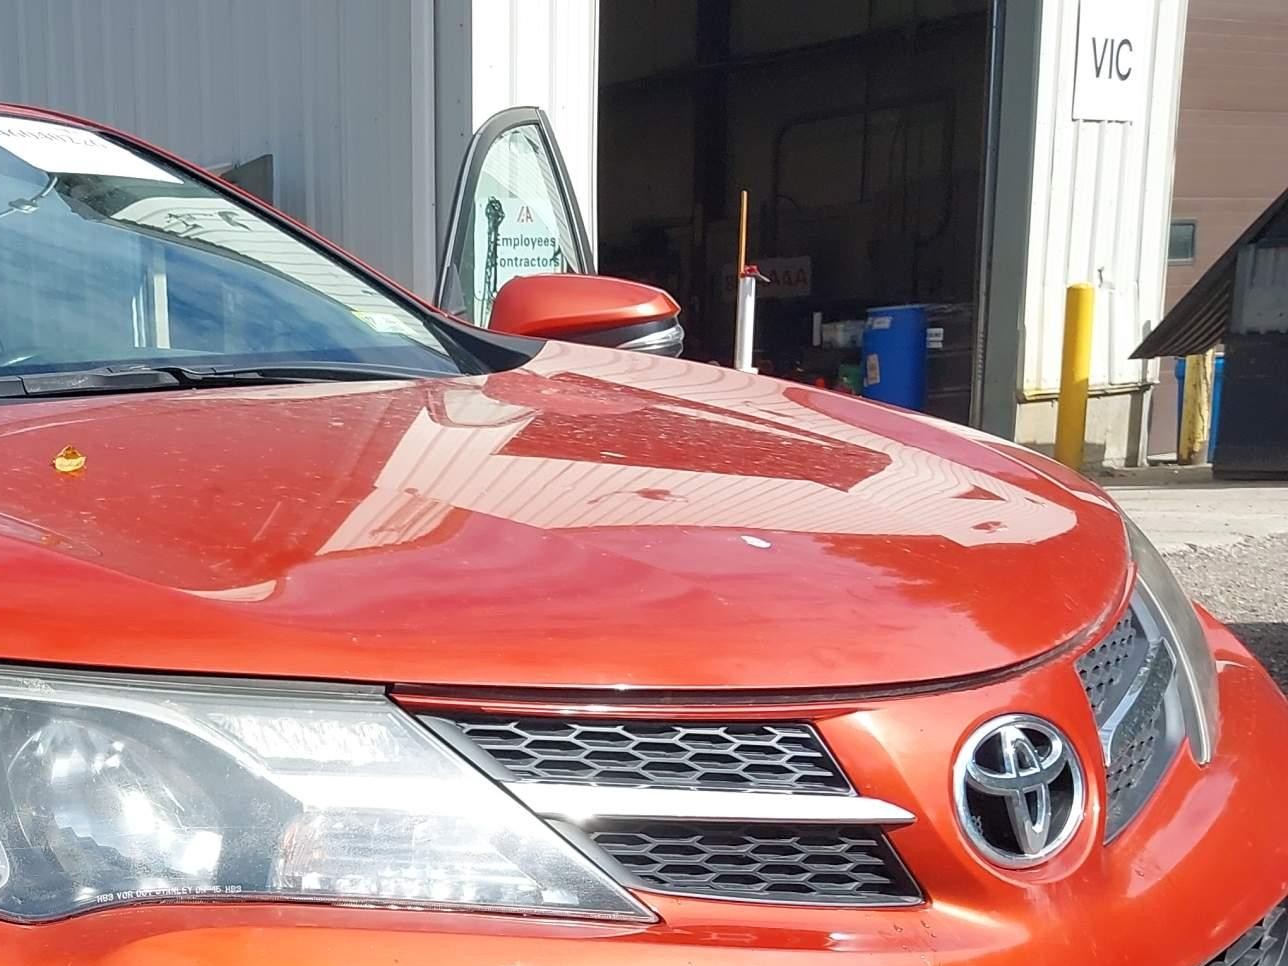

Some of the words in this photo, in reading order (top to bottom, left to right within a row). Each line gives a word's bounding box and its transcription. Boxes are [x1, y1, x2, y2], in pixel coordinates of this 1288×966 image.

[1091, 36, 1133, 81] VIC
[496, 234, 556, 250] Employees
[495, 256, 560, 268] ontractors
